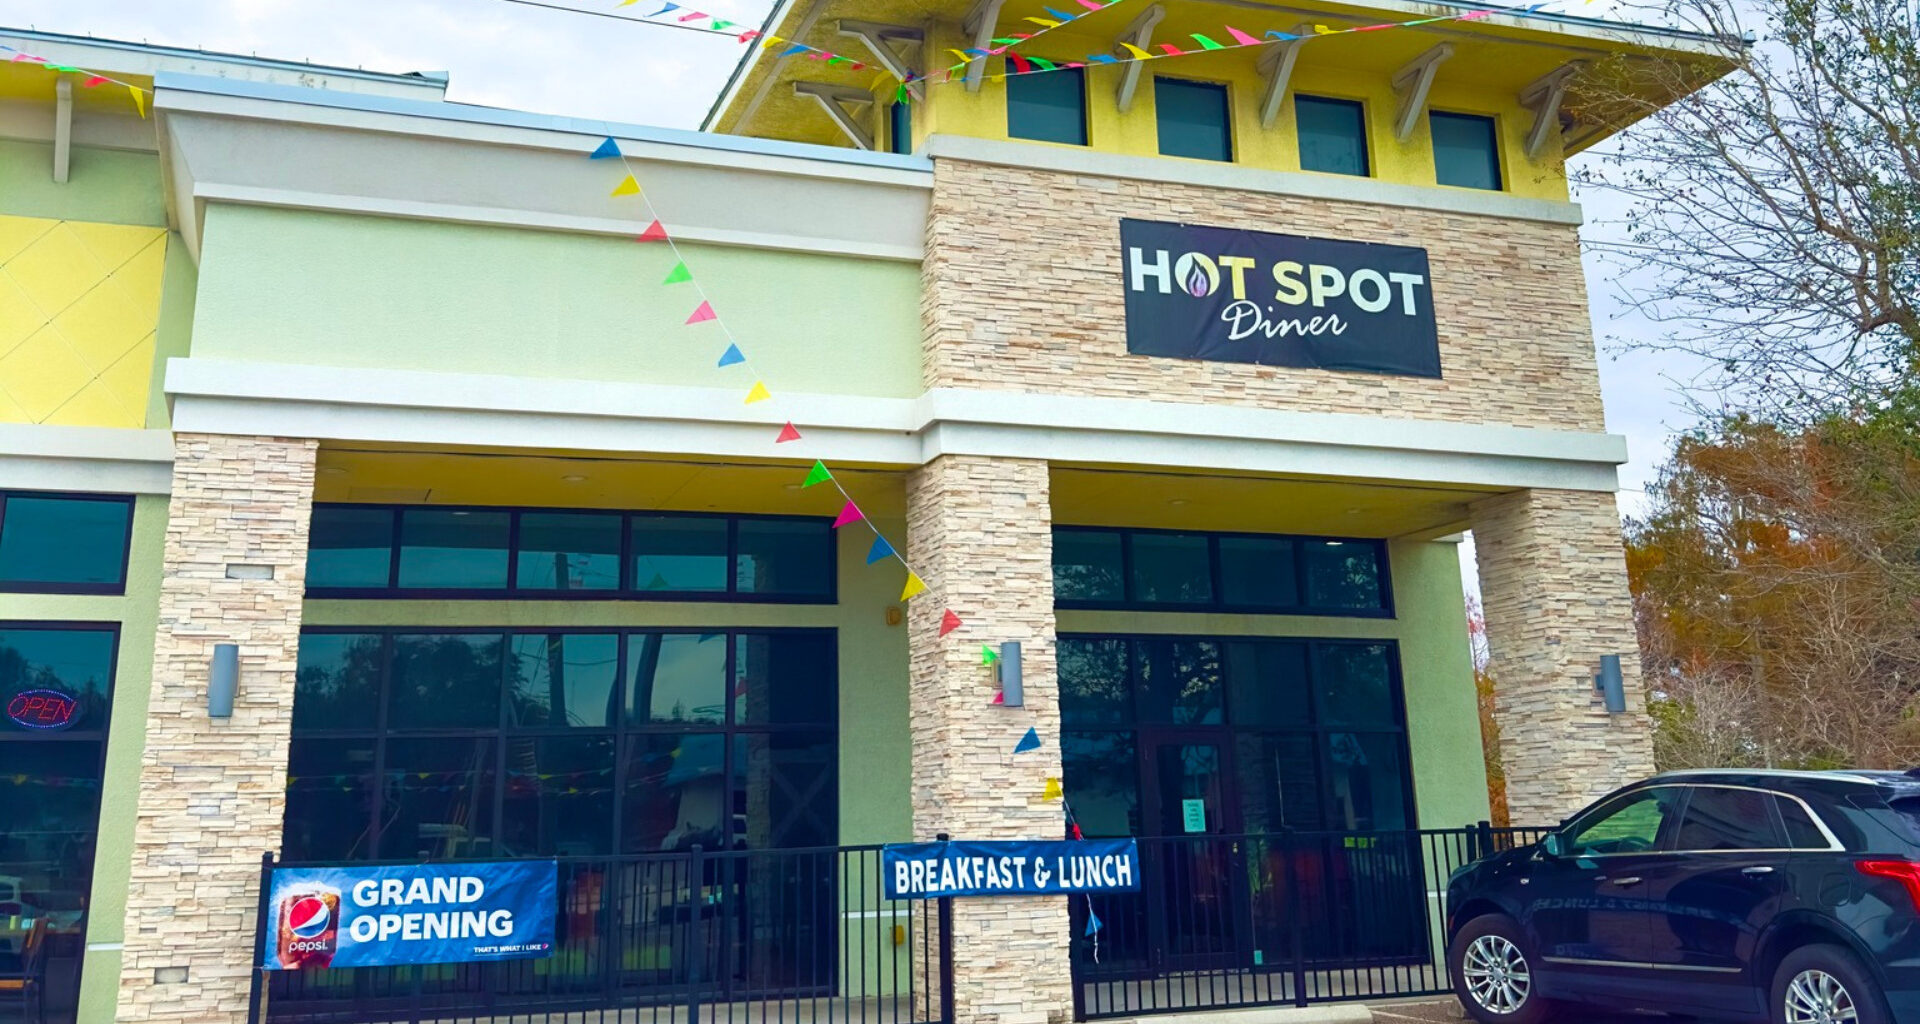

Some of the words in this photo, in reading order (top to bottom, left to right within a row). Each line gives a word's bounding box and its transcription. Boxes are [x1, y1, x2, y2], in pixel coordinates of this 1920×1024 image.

[1129, 247, 1255, 300] HOT
[1272, 260, 1424, 316] SPOT
[1221, 300, 1347, 340] Diner
[7, 696, 77, 723] OPEN
[895, 856, 1026, 894] BREAKFAST
[1034, 856, 1051, 888] &
[1058, 854, 1132, 888] LUNCH
[352, 876, 484, 908] GRAND
[350, 909, 514, 943] OPENING
[289, 938, 327, 954] pepsi
